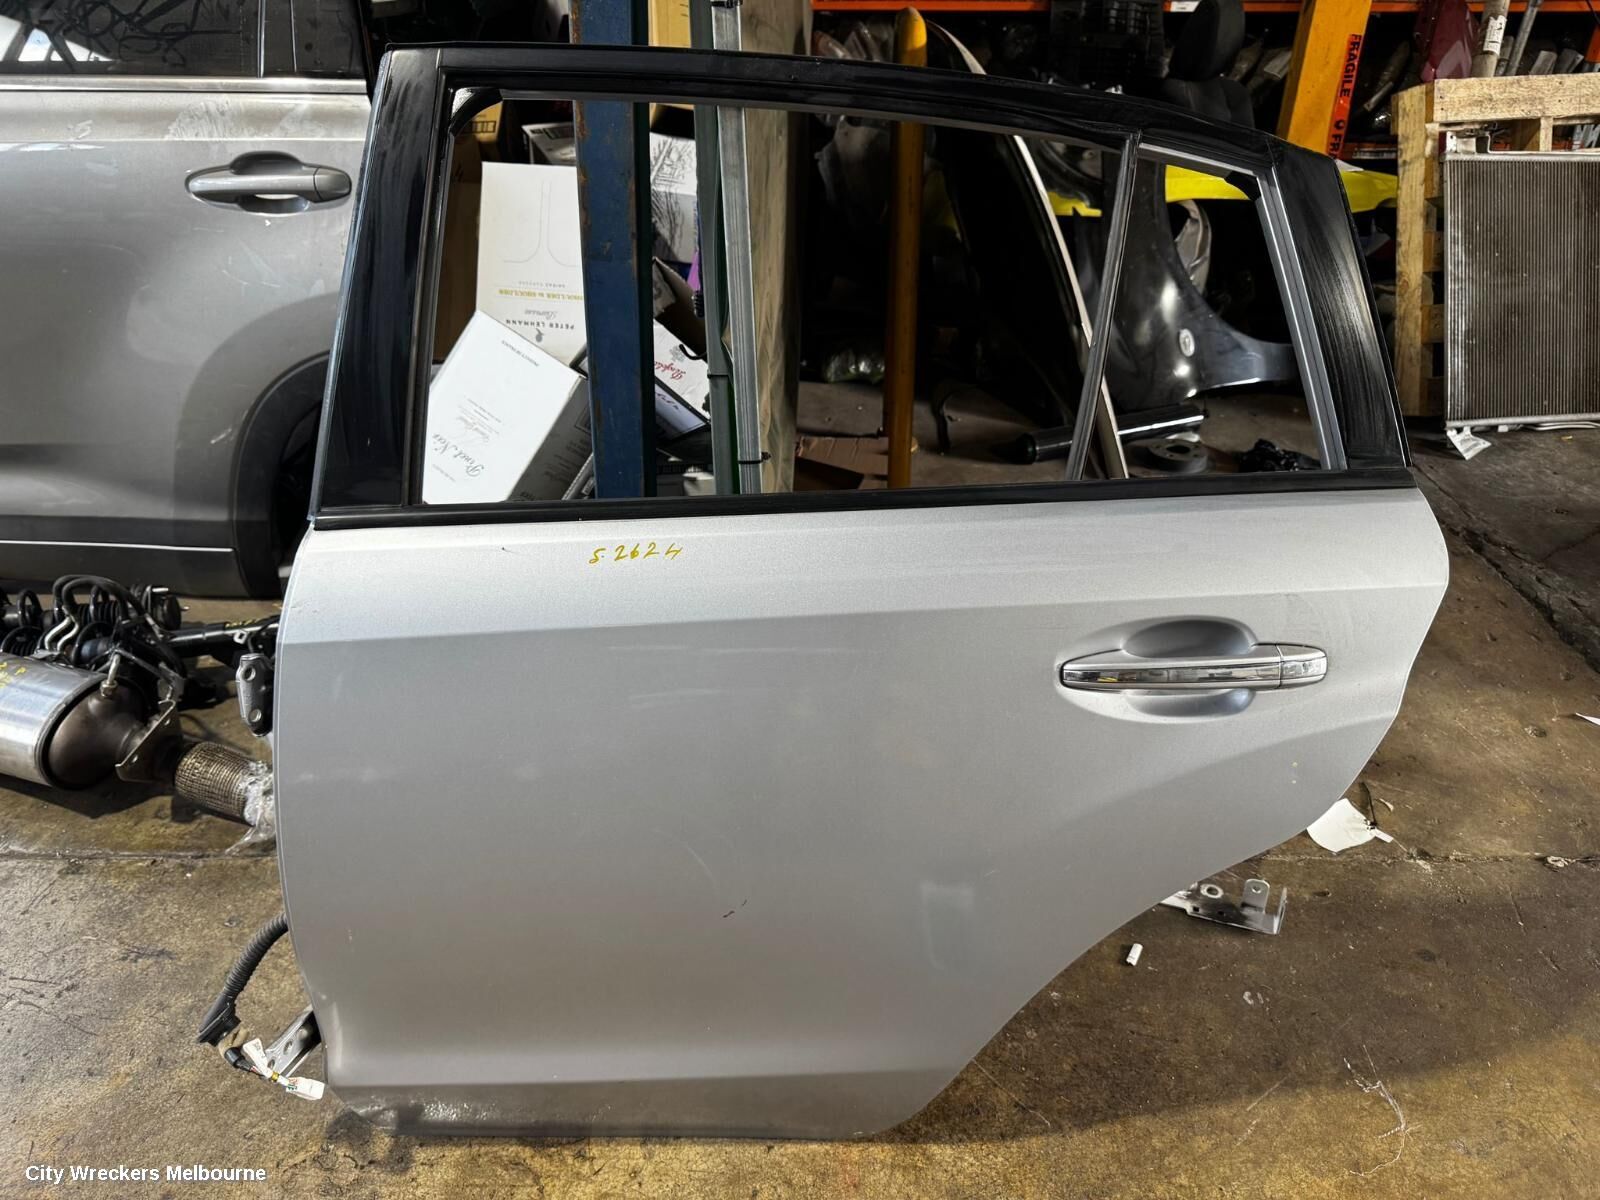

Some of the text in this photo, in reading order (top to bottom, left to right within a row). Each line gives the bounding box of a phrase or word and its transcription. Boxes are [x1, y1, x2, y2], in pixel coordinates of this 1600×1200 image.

[1340, 34, 1362, 97] FRAGILE
[505, 319, 575, 330] PETER LEHMANN
[432, 433, 458, 455] Noir
[452, 450, 485, 477] Pinot
